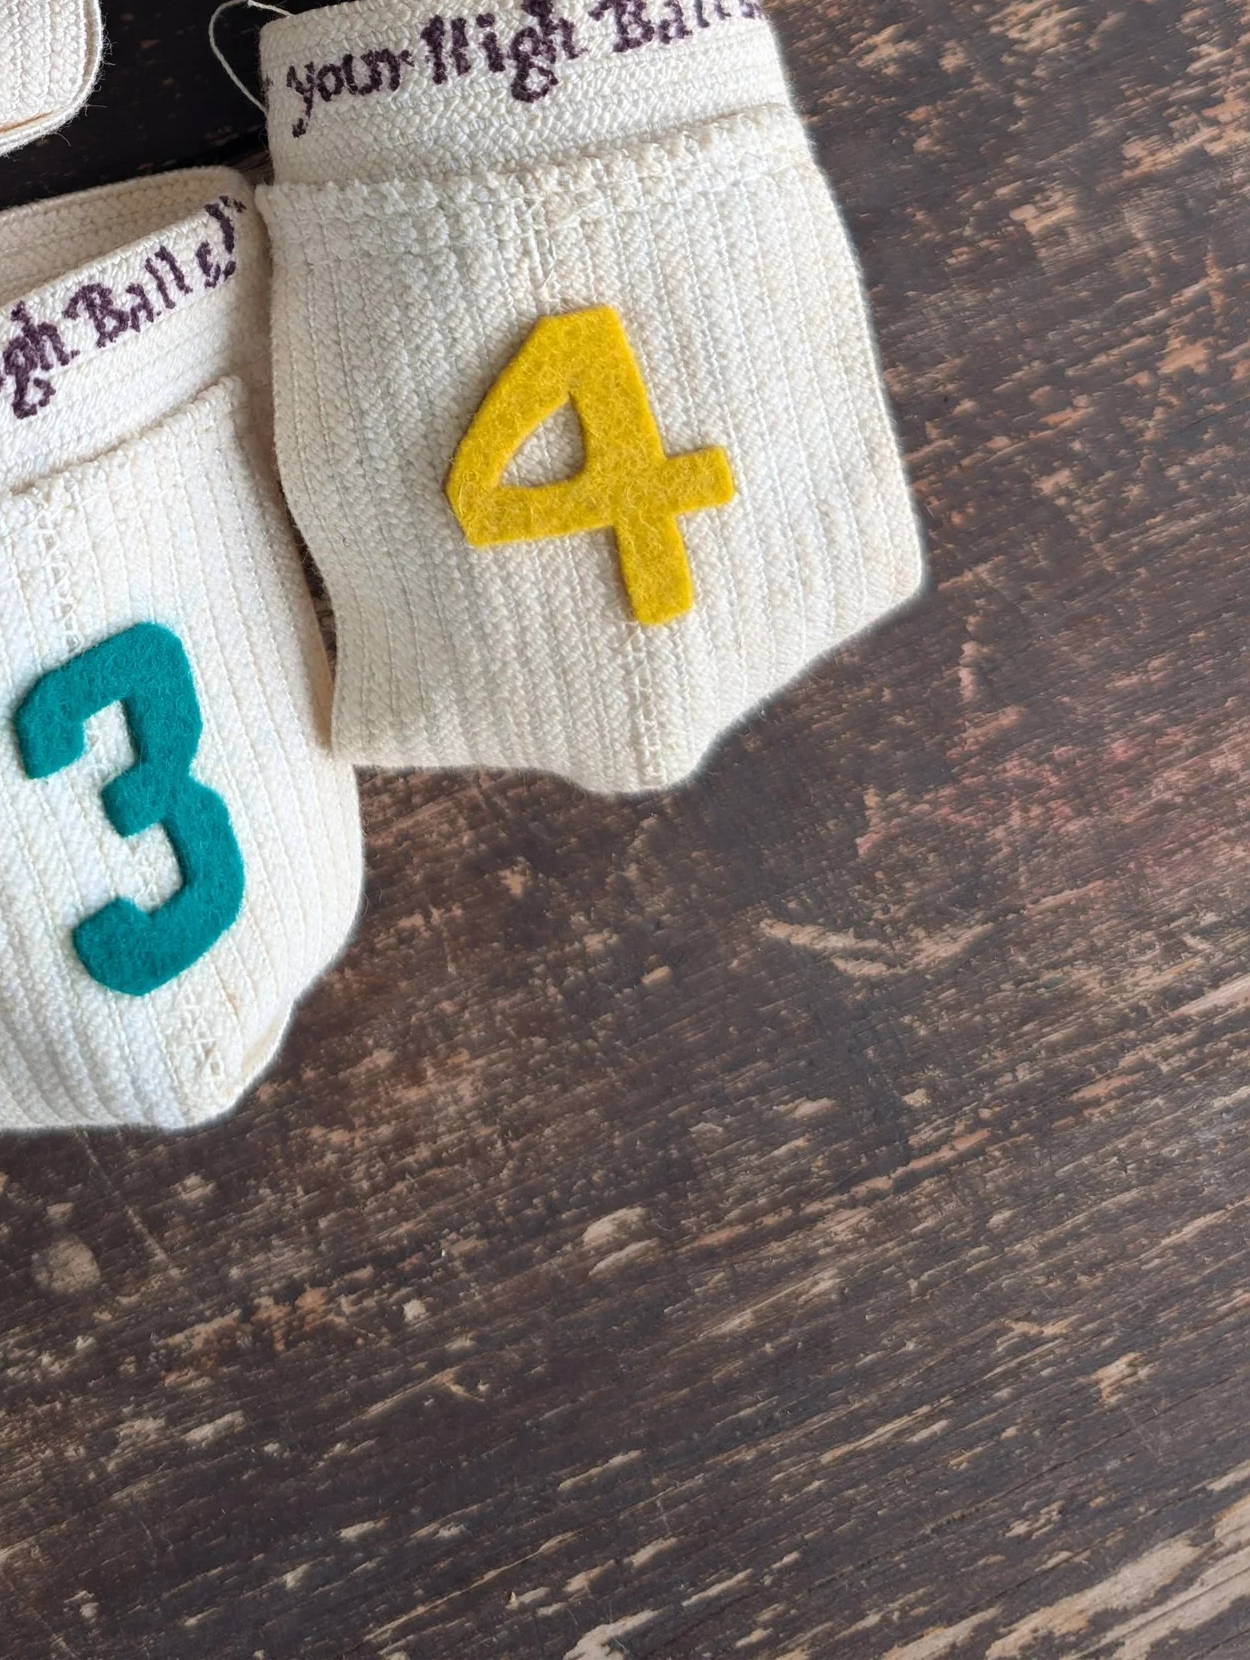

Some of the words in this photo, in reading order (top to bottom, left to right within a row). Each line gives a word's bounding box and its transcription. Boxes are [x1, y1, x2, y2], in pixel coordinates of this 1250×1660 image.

[286, 48, 415, 138] your
[441, 305, 736, 627] 4
[13, 621, 245, 996] 3
